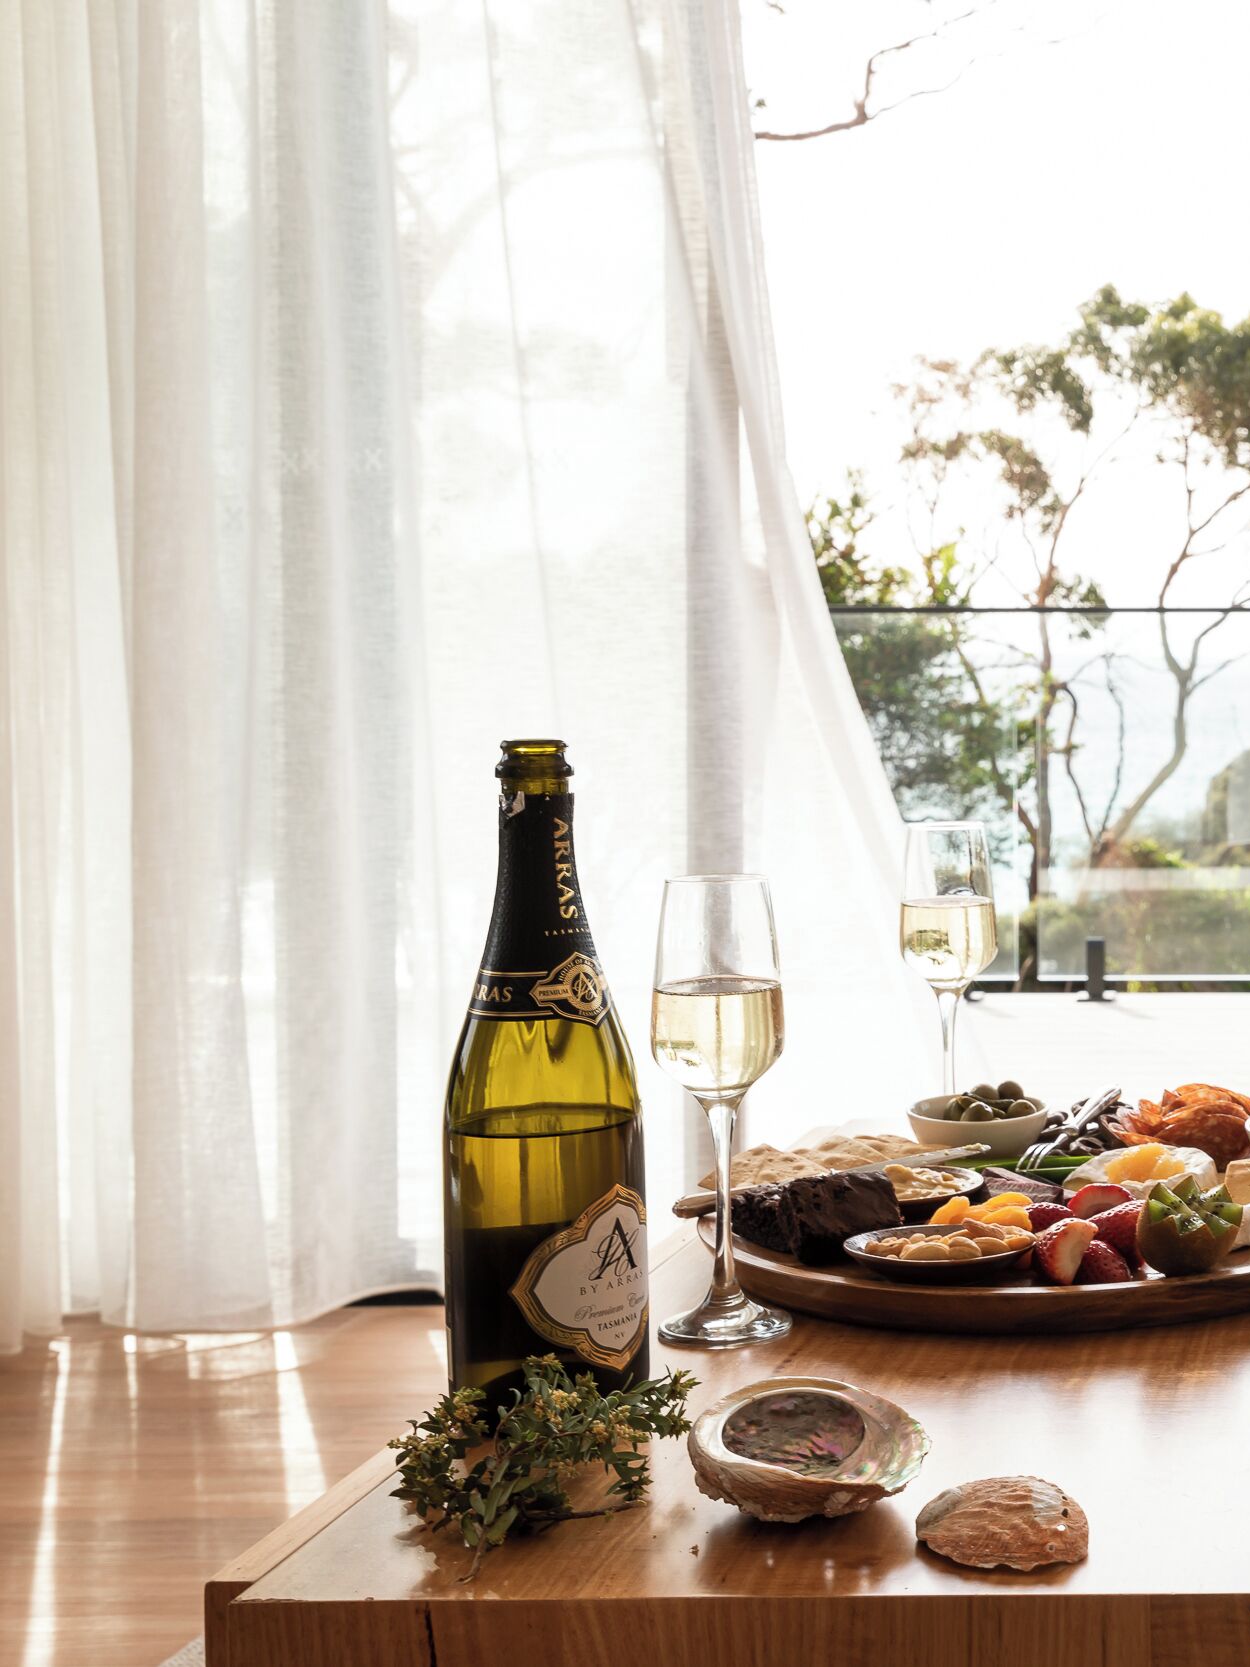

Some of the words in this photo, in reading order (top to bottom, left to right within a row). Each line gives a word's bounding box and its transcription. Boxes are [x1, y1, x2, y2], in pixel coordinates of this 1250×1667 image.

[553, 817, 578, 919] ARRAS
[538, 988, 568, 997] PREMIUM
[580, 1284, 598, 1296] BY
[574, 1304, 624, 1322] Premium
[597, 1312, 637, 1332] TASMANIA
